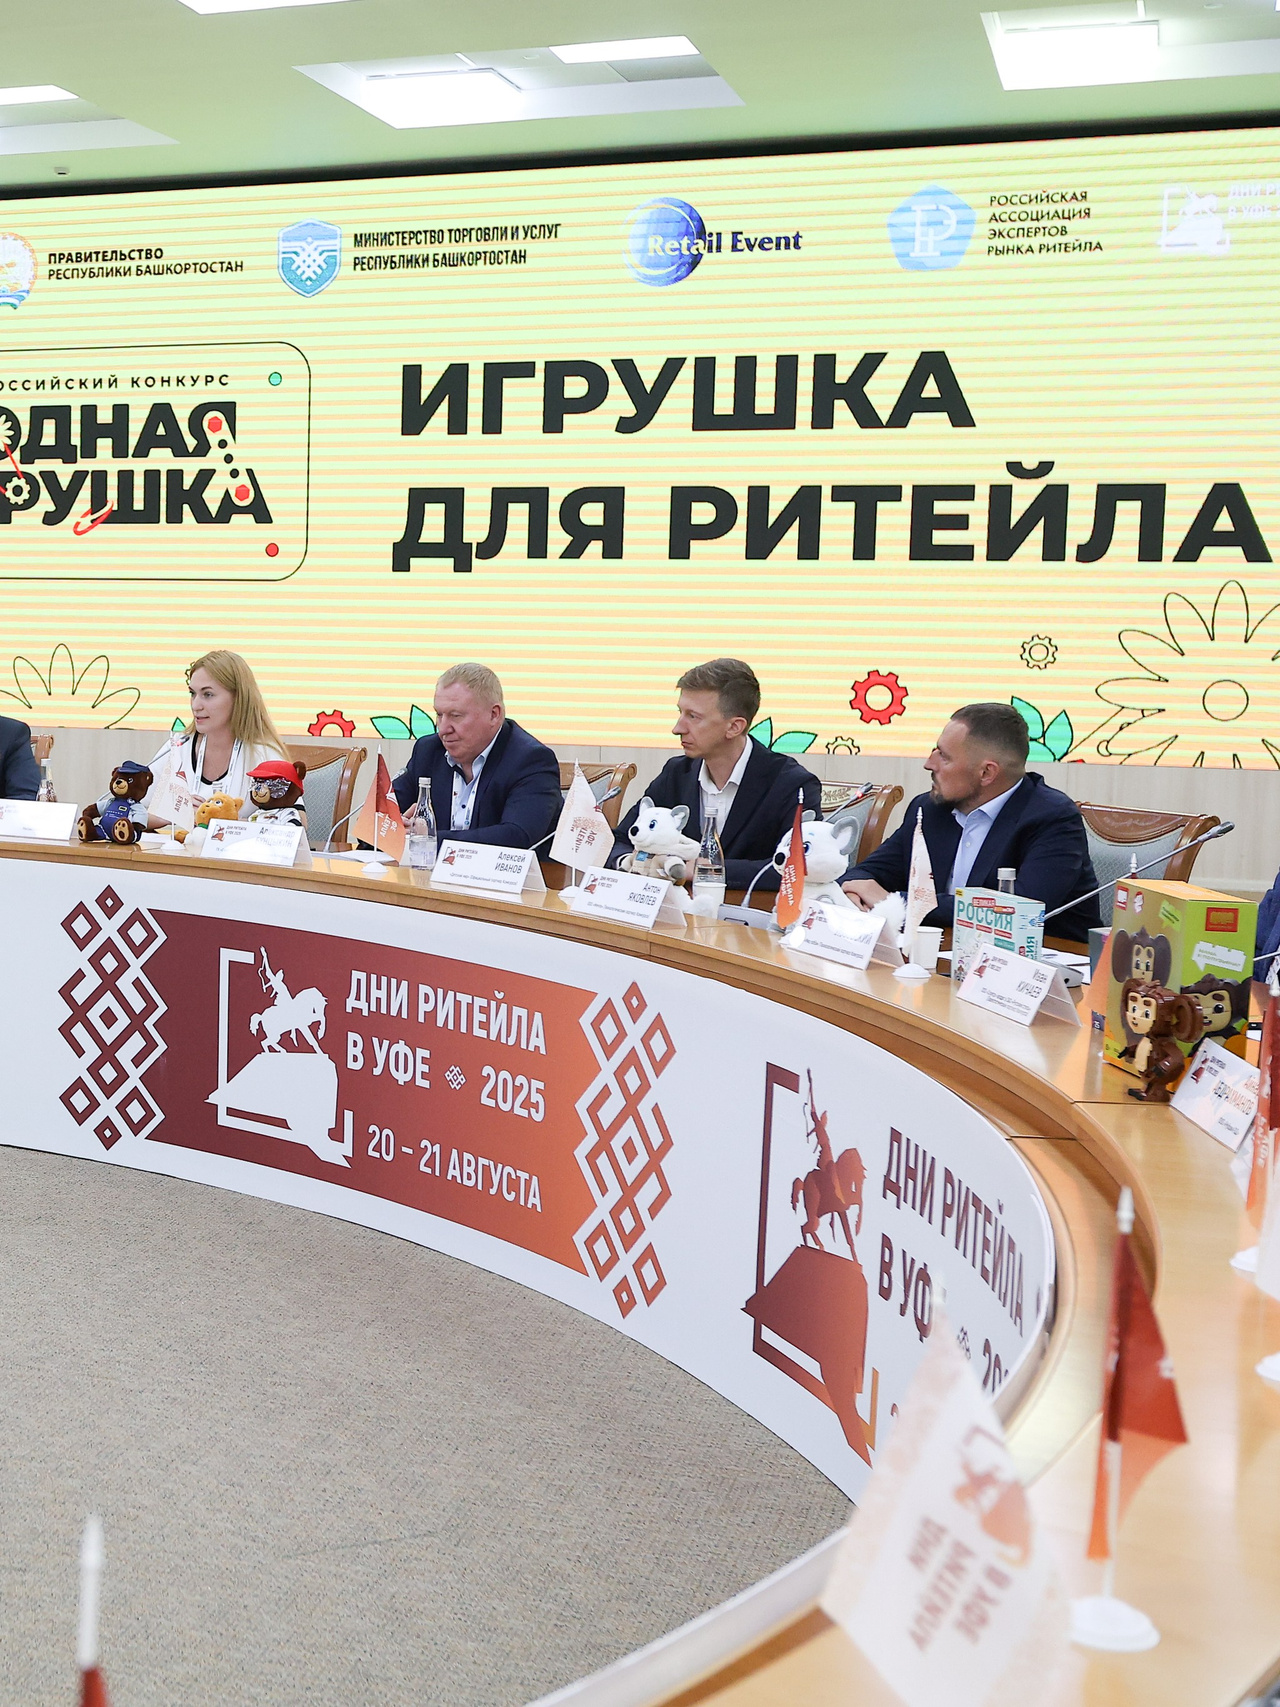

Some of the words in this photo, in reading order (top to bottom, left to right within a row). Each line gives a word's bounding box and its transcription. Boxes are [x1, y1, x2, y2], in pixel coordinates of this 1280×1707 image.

[990, 190, 1088, 206] РОССИЙСКАЯ
[988, 207, 1091, 223] АССОЦИАЦИЯ
[353, 230, 444, 248] МИНИСТЕРСТВО
[447, 226, 508, 245] ТОРГОВЛИ
[511, 226, 519, 241] И
[522, 223, 562, 241] УСЛУГ
[987, 225, 1068, 240] ЭКСПЕРТОВ
[648, 232, 722, 258] Retail
[731, 231, 803, 253] Event
[987, 242, 1034, 257] РЫНКА
[1038, 238, 1103, 255] РИТЕЙЛА
[47, 247, 164, 265] ПРАВИТЕЛЬСТВО
[353, 253, 430, 272] РЕСПУБЛИКИ
[432, 249, 527, 268] БАШКОРТОСТАН
[47, 264, 132, 281] РЕСПУБЛИКИ
[134, 260, 244, 277] БАШКОРТОСТАН
[131, 374, 231, 389] КОНКУРС
[401, 350, 976, 436] ИГРУШКА
[392, 486, 625, 573] ДЛЯ
[668, 461, 1273, 564] РИТЕЙЛА
[498, 851, 526, 863] Алексей
[494, 863, 523, 874] ИВАНОВ
[627, 892, 657, 906] ЯКОВЛЕВ
[642, 882, 662, 894] Антон
[957, 900, 1013, 931] РОССИЯ
[346, 969, 408, 1019] ДНИ
[418, 983, 547, 1055] РИТЕЙЛА
[346, 1032, 364, 1071] В
[373, 1038, 431, 1088] УФЕ
[480, 1065, 545, 1123] 2025
[368, 1124, 395, 1161] 20
[419, 1139, 441, 1176] 21
[447, 1149, 542, 1213] АВГУСТА
[883, 1126, 936, 1225] ДНИ
[940, 1166, 1024, 1338] РИТЕЙЛА
[879, 1232, 894, 1301] В
[899, 1248, 938, 1343] УФ
[982, 1338, 1009, 1394] 20
